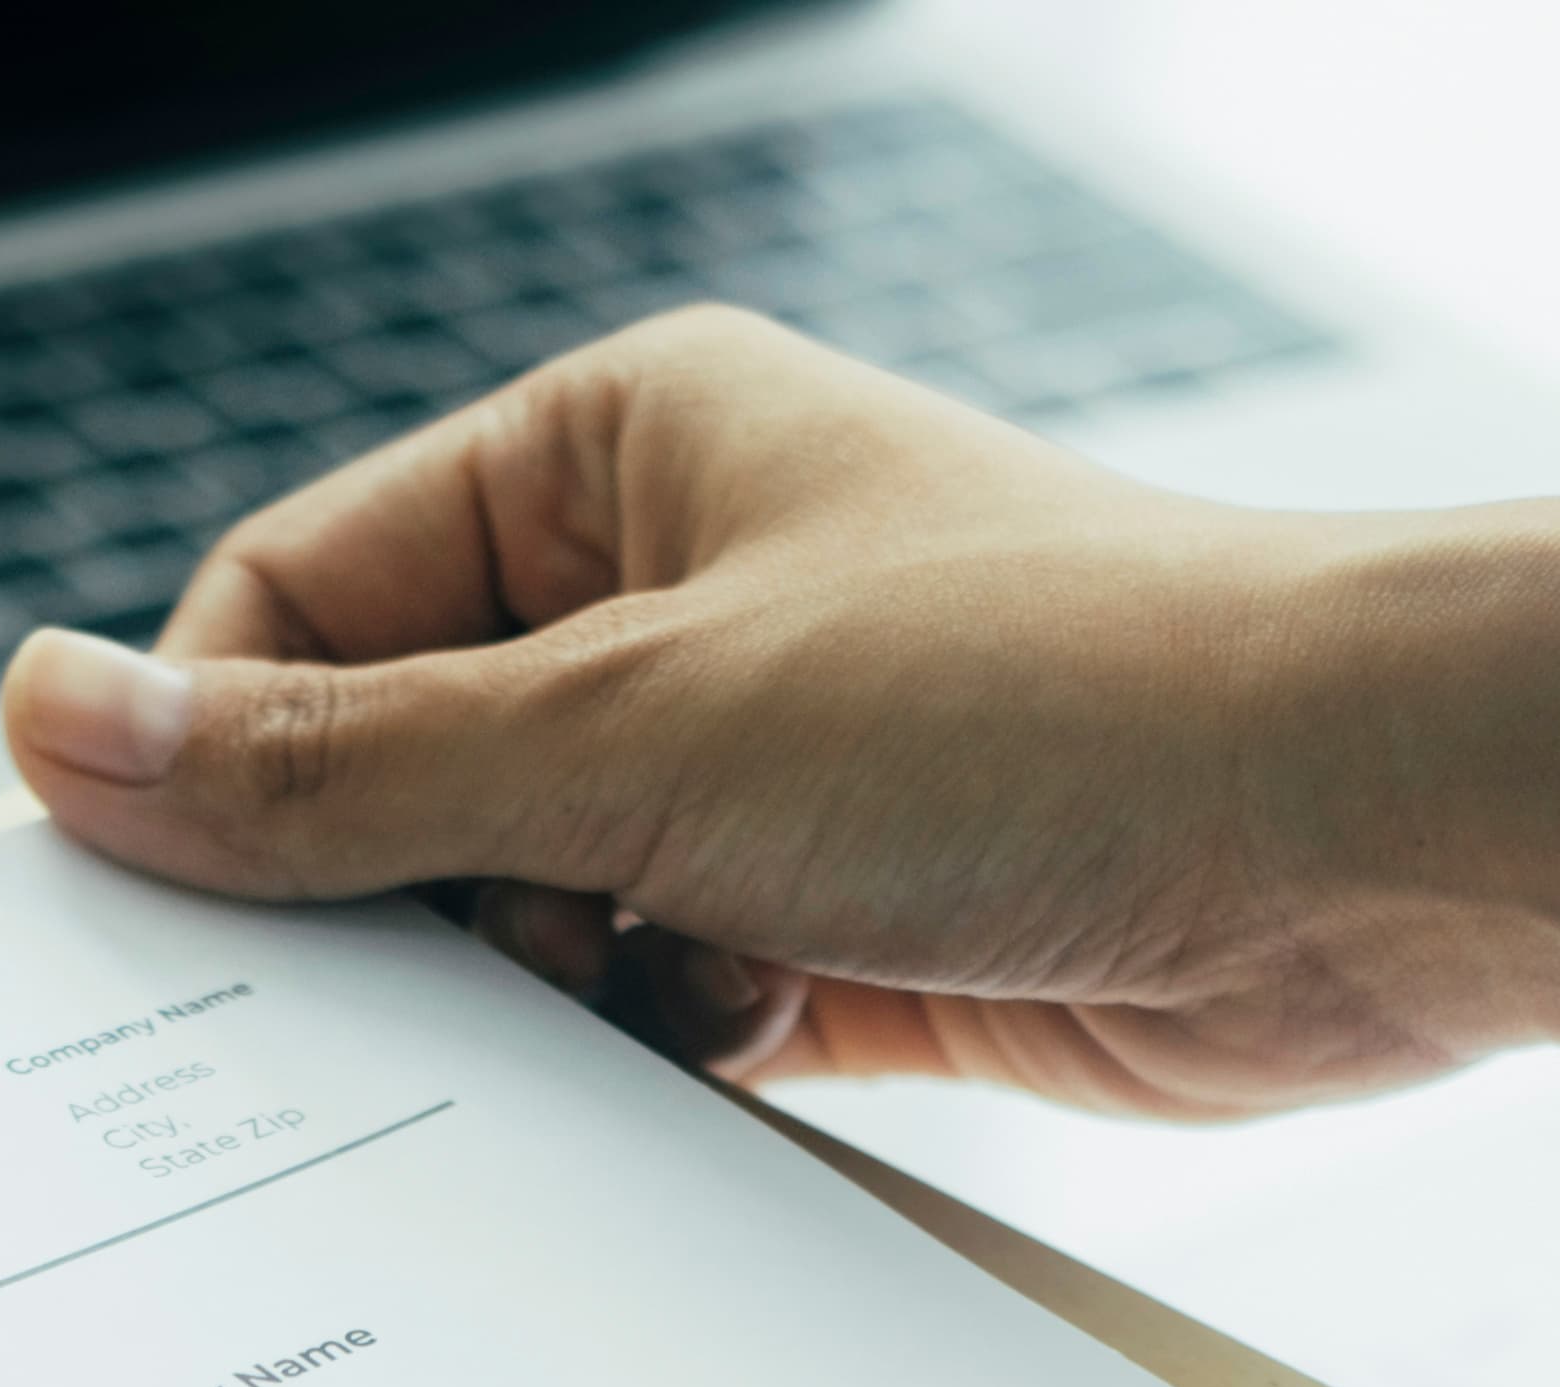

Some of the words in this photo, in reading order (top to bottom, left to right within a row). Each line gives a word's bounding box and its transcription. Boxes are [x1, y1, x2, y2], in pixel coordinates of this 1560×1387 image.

[4, 1014, 157, 1076] Company
[158, 981, 255, 1023] Name
[67, 1059, 217, 1124] Address
[102, 1112, 192, 1151] City,
[138, 1130, 238, 1179] State
[238, 1105, 307, 1143] Zip
